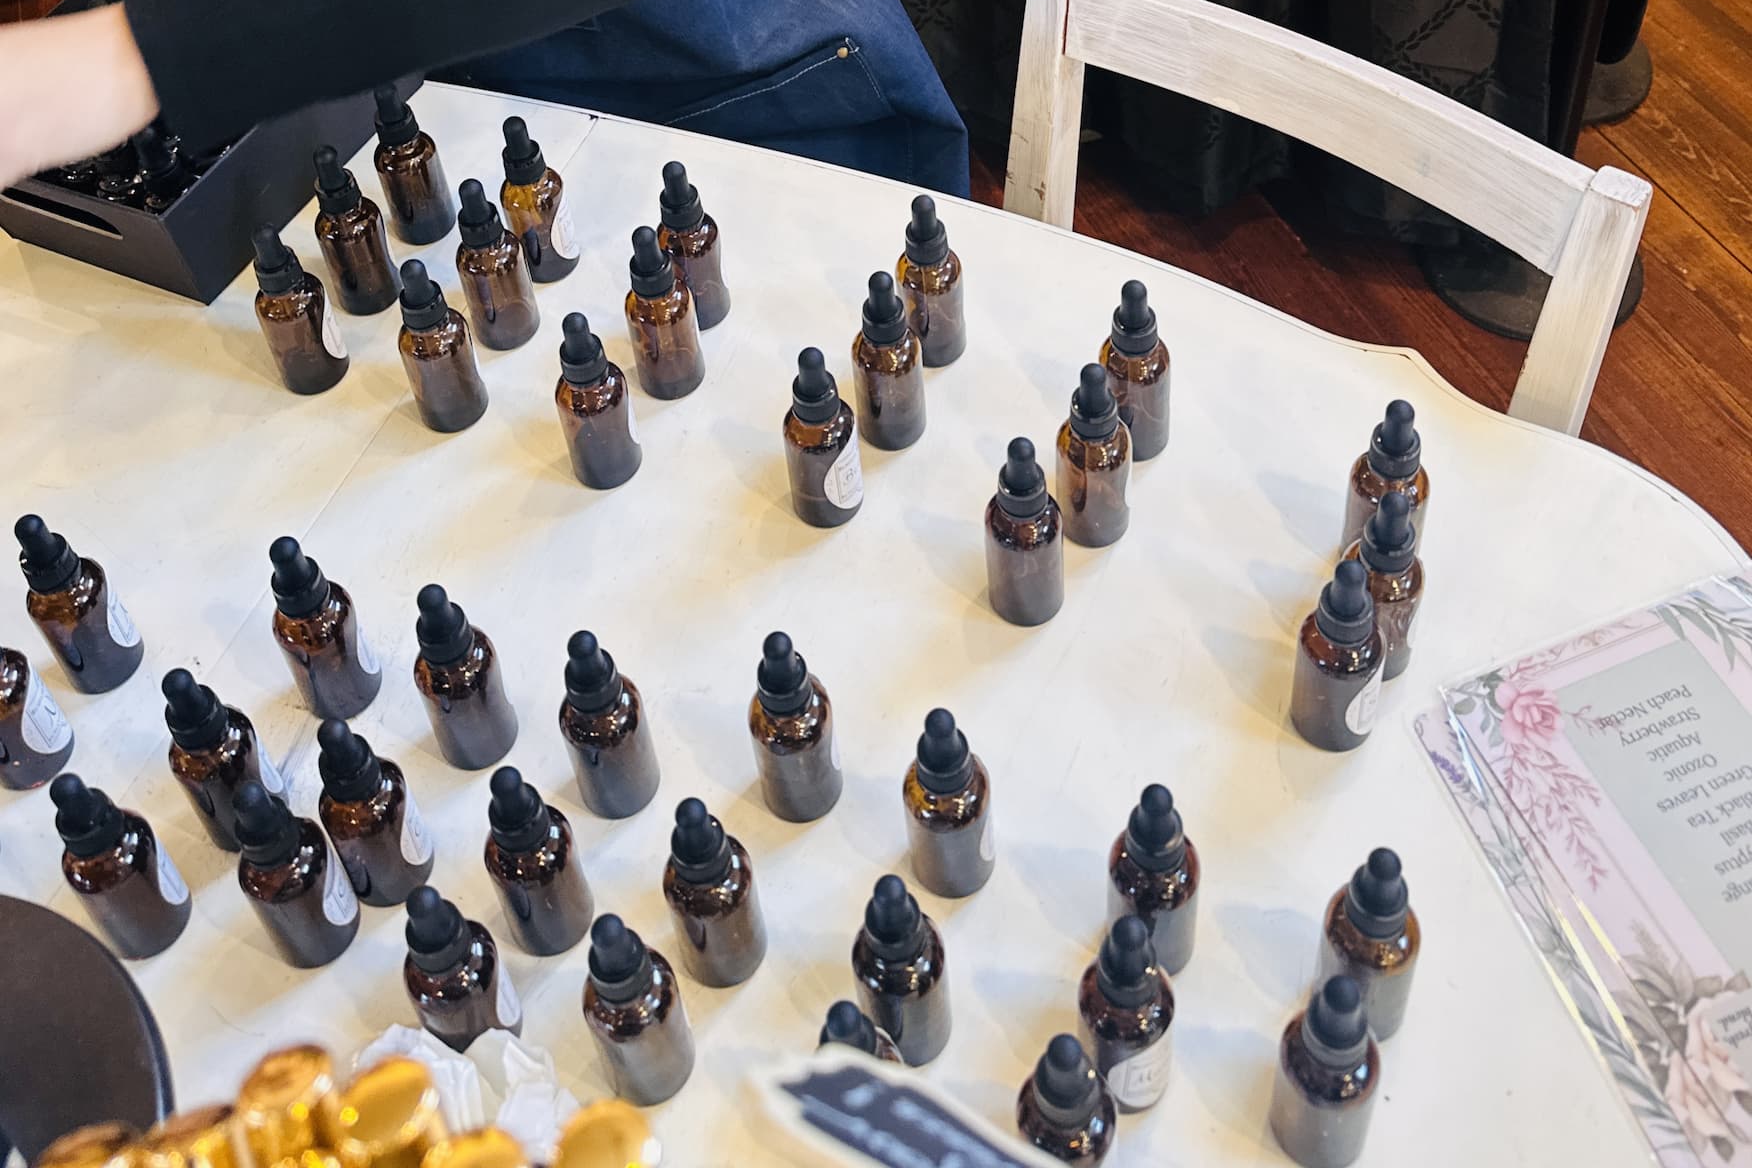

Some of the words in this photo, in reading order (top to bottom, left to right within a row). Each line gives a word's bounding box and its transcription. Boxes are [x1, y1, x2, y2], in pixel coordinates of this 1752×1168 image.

[1646, 684, 1693, 711] Peach
[1599, 701, 1649, 730] Nectar
[1619, 706, 1701, 747] Strawberry
[1647, 731, 1702, 762] Aquatic
[1663, 753, 1717, 782] Ozonic
[1656, 784, 1711, 813] Leaves
[1687, 809, 1720, 828] Tea
